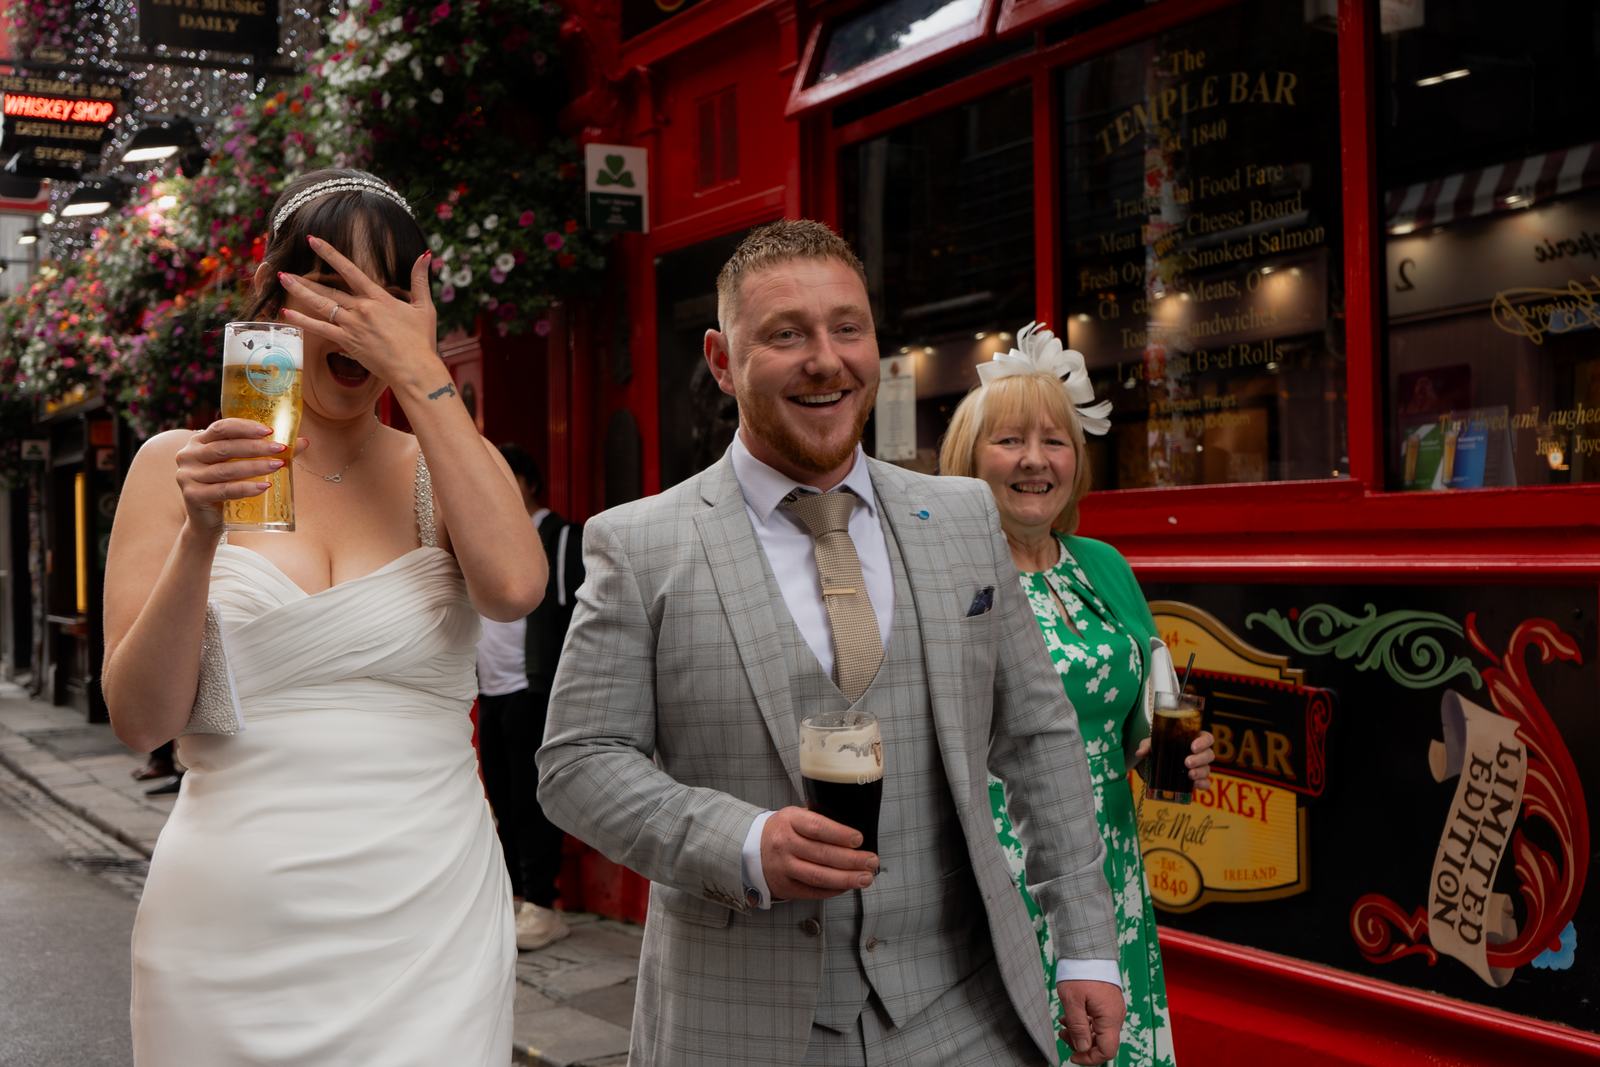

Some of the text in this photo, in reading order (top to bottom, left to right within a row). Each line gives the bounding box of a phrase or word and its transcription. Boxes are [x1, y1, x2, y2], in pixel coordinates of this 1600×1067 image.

[178, 14, 239, 33] DAILY
[1171, 49, 1207, 76] The
[4, 93, 115, 123] WHISKEY SHOP
[1096, 70, 1299, 155] TEMPLE BAR
[1190, 118, 1228, 147] 1840
[1199, 166, 1242, 200] Food
[1246, 161, 1285, 187] Fare
[1186, 207, 1245, 237] Cheese
[1250, 191, 1303, 222] Board
[1187, 234, 1253, 269] Smoked
[1257, 223, 1326, 252] Salmon
[1238, 339, 1284, 366] Rolls
[1511, 404, 1541, 430] and
[1210, 722, 1297, 780] BAR
[1193, 776, 1274, 823] SKEY
[1167, 811, 1213, 851] Malt
[1432, 752, 1493, 930] EDITION
[1458, 742, 1522, 946] LIMITED
[1151, 870, 1189, 898] 1840
[1223, 865, 1278, 881] IRELAND
